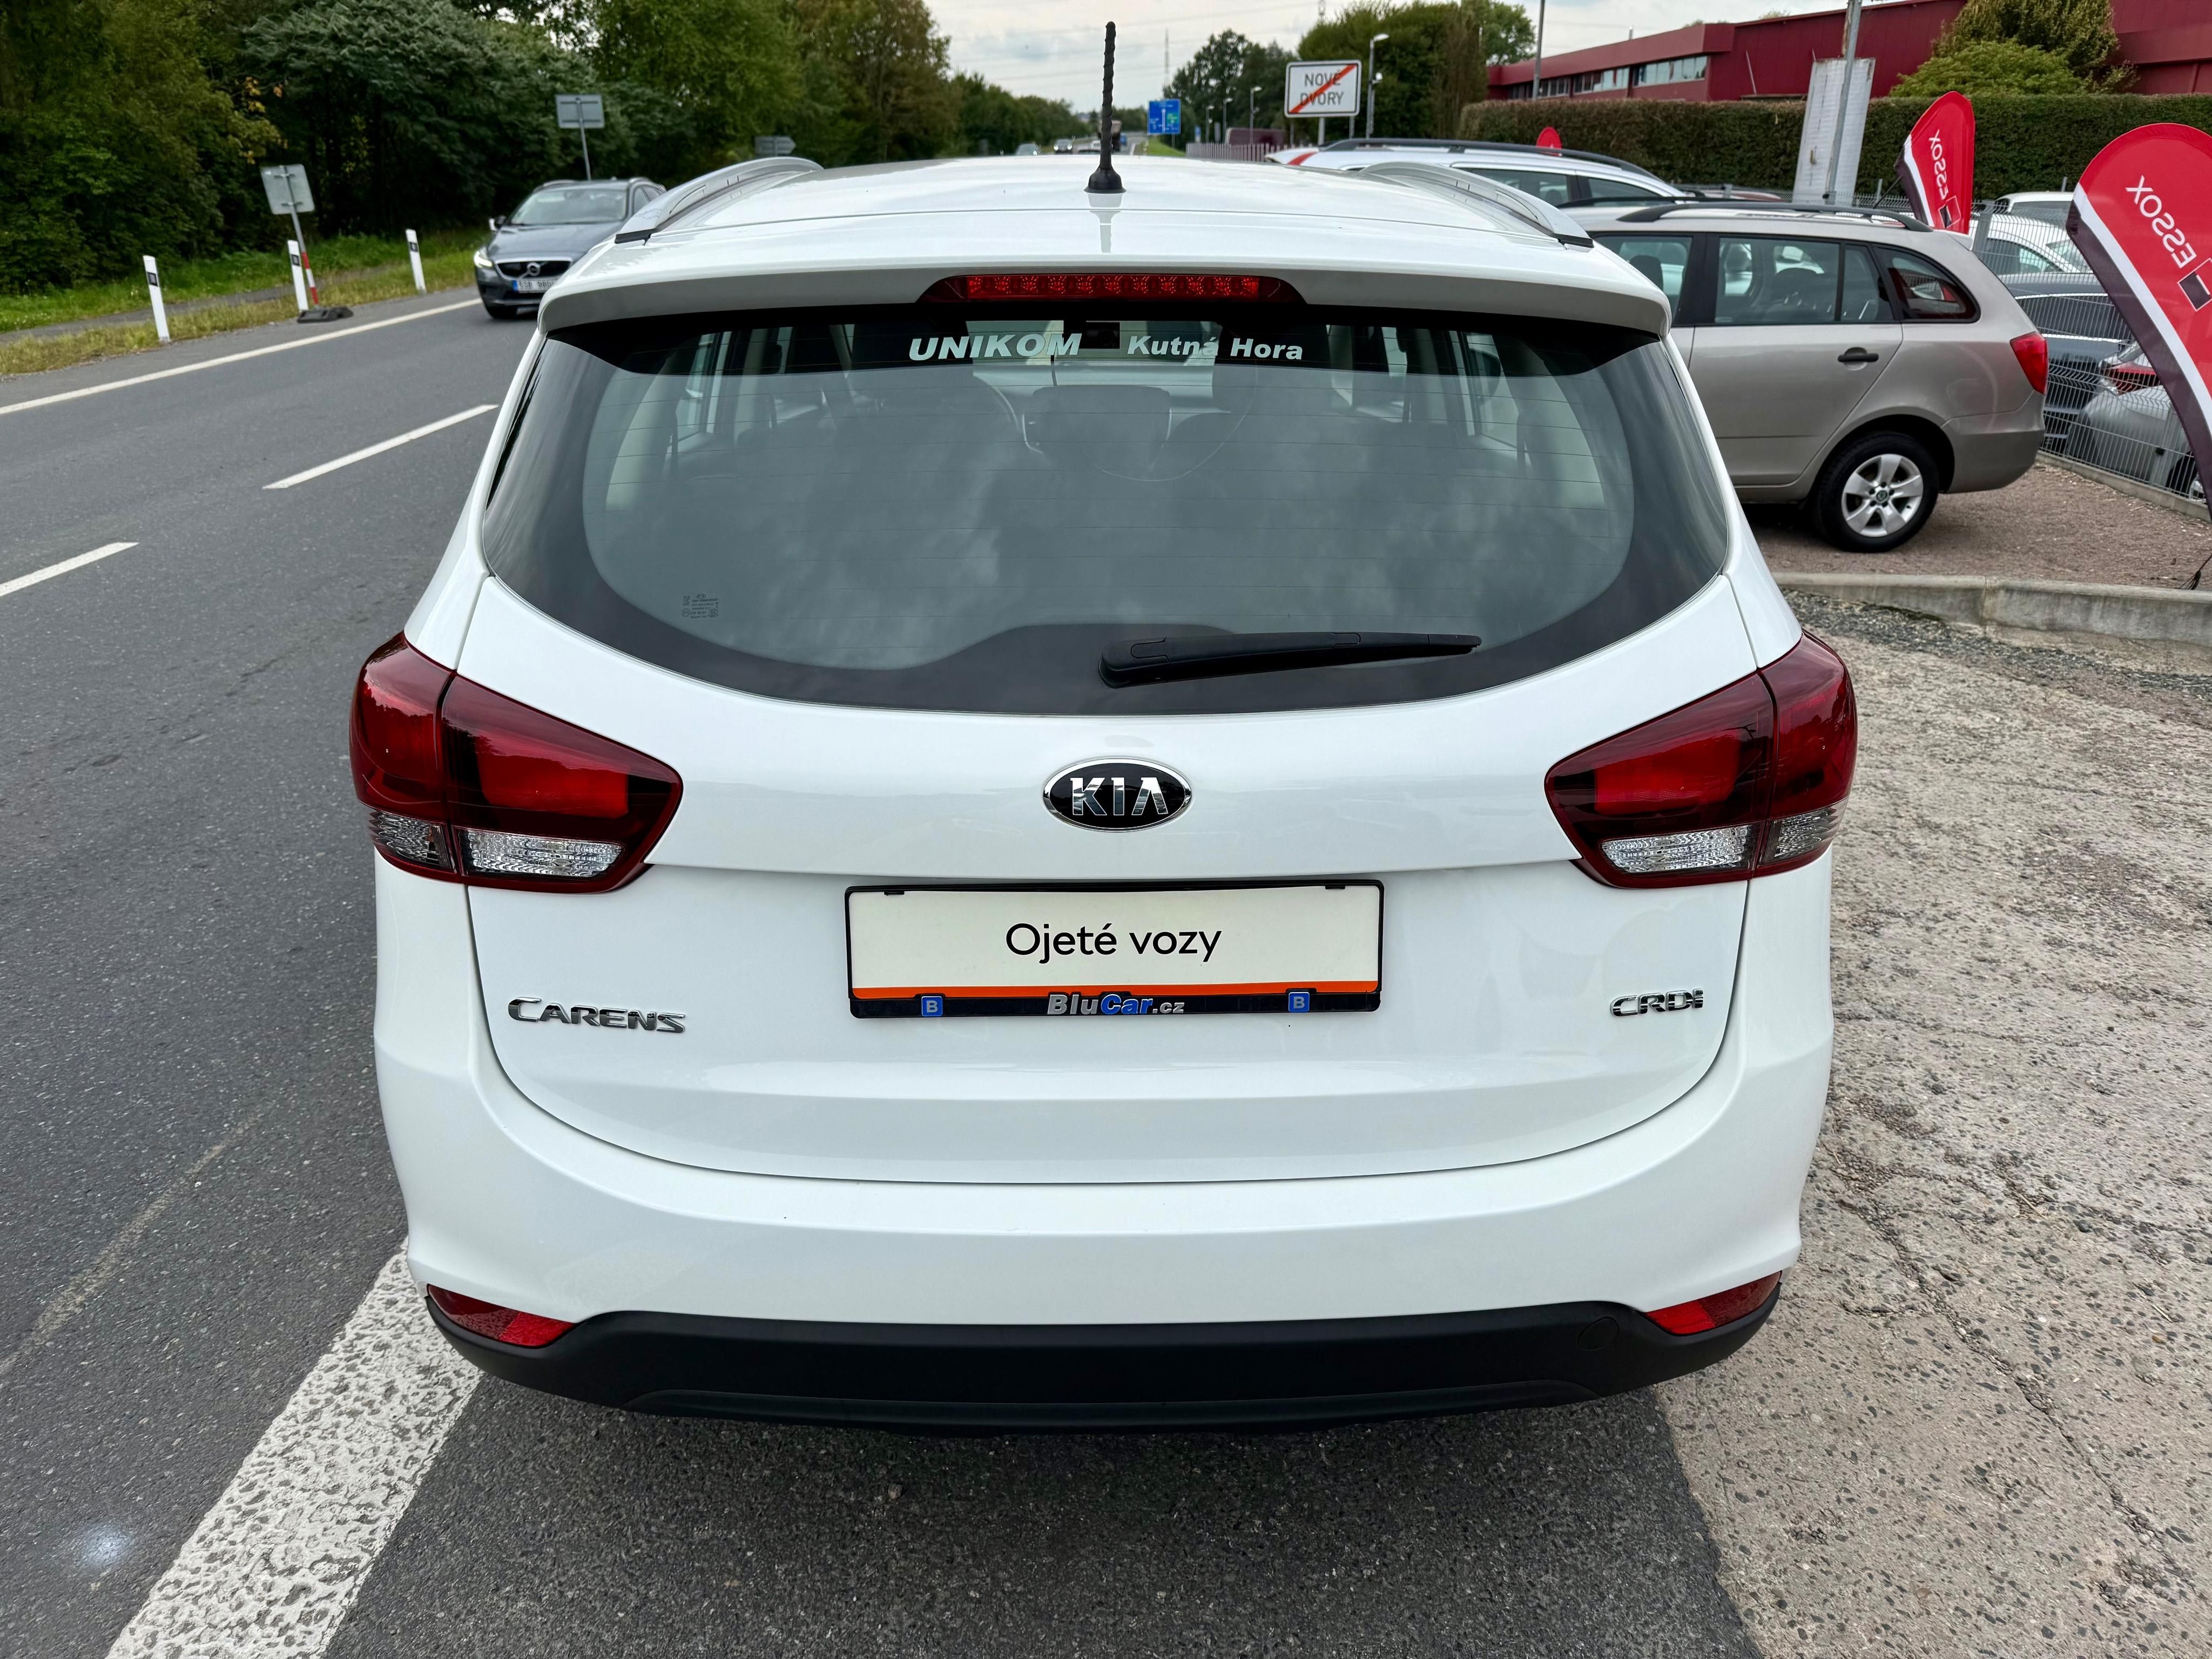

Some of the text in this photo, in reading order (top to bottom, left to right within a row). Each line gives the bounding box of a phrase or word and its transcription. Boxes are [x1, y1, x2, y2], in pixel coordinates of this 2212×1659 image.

[1304, 69, 1341, 87] NOVÉ
[1300, 91, 1344, 106] DVORY
[909, 333, 1303, 361] UNIKOM Kutná Hora
[1070, 777, 1169, 816] KIA
[1006, 922, 1222, 964] Ojeté vozy
[926, 1000, 938, 1013] B
[1047, 994, 1185, 1015] BluCar.cz
[1293, 996, 1305, 1009] B
[508, 996, 686, 1034] CARENS
